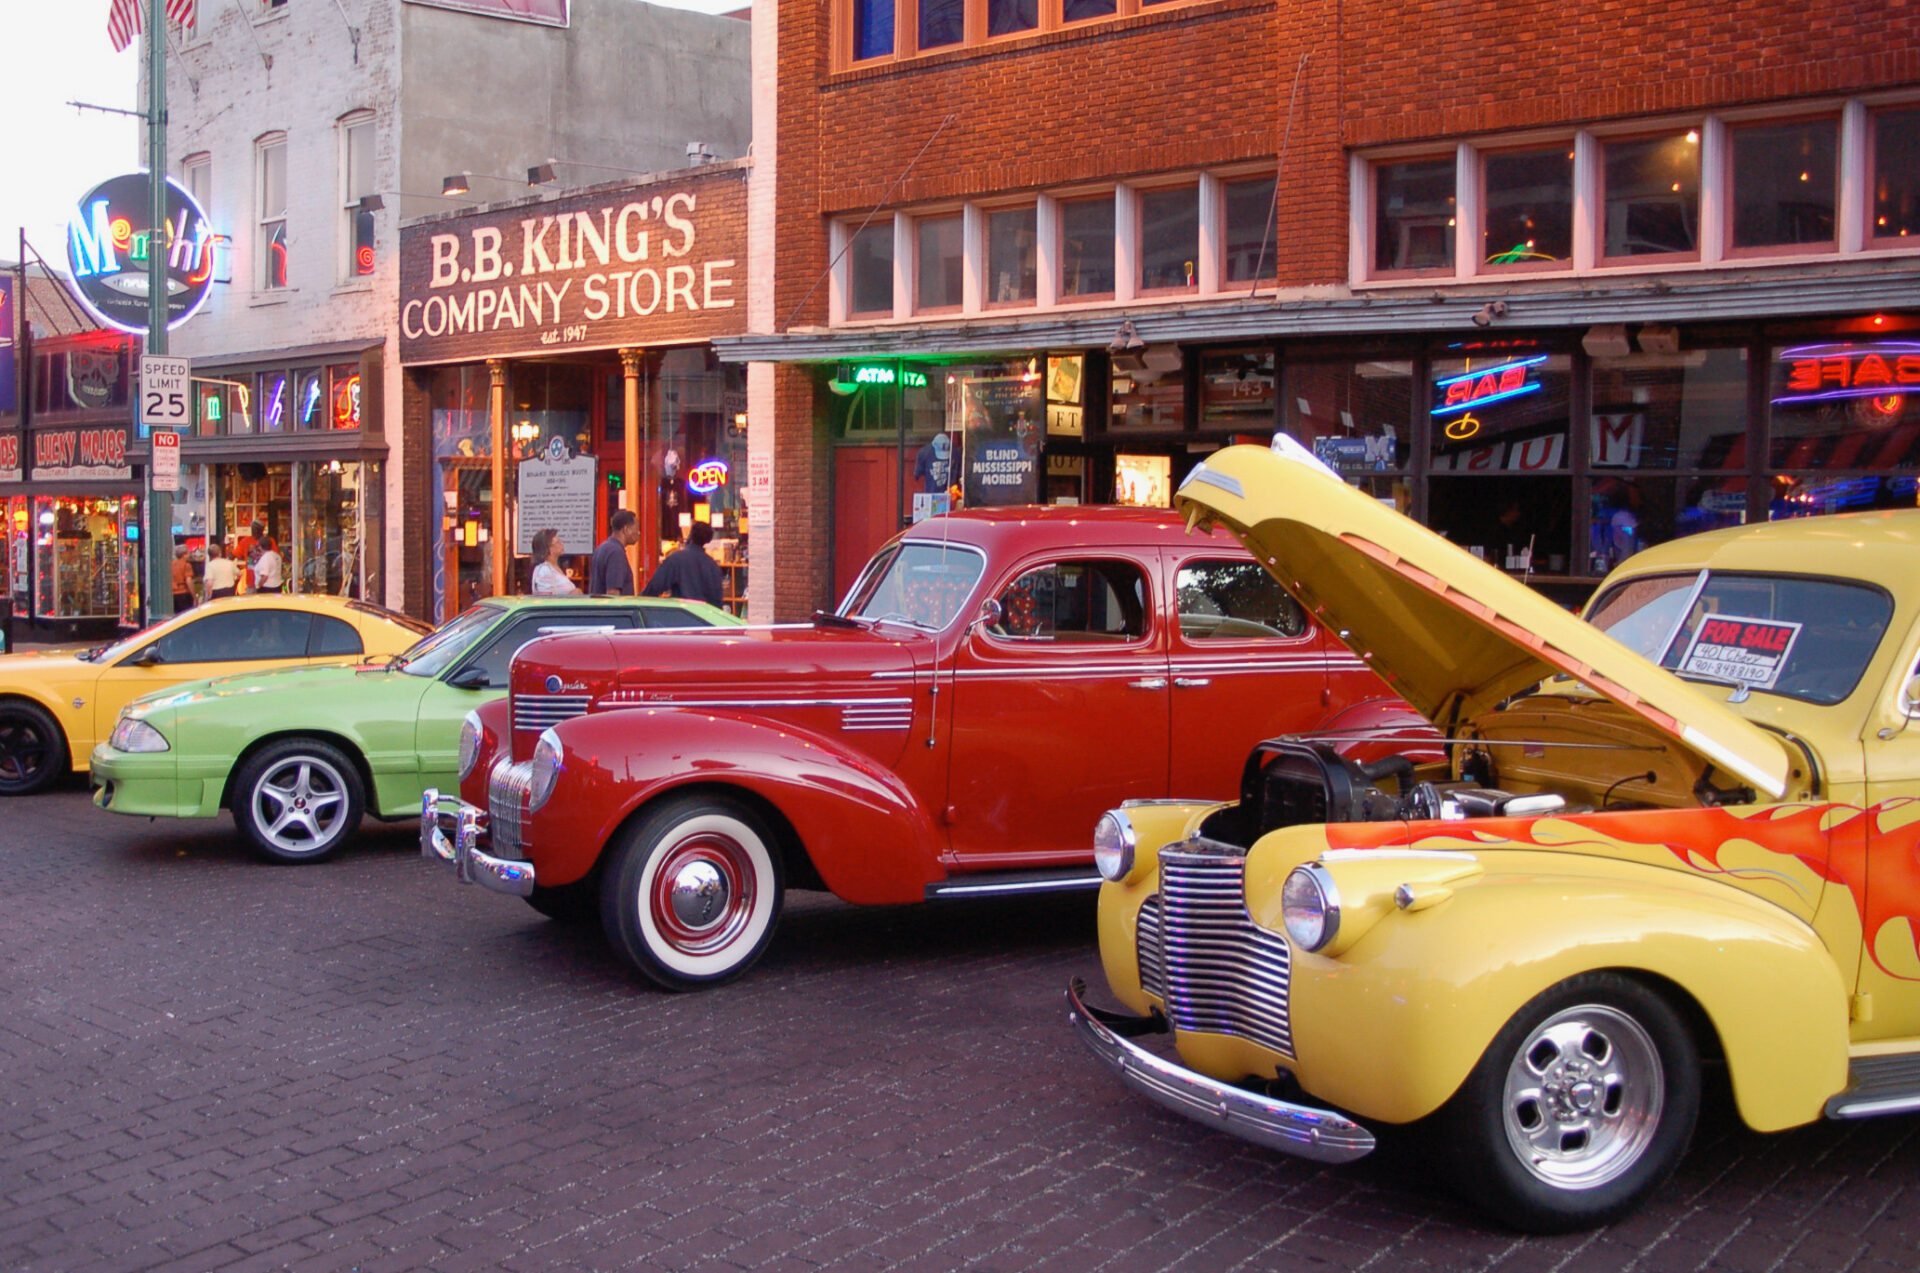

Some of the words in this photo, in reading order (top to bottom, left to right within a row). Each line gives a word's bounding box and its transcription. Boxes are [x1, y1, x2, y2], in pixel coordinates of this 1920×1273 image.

[67, 199, 225, 287] Memhis
[430, 227, 513, 288] B.B.
[520, 192, 698, 275] KING'S
[402, 278, 572, 339] COMPANY
[583, 259, 736, 320] STORE
[541, 328, 561, 345] est.
[562, 325, 587, 343] 1947
[145, 364, 185, 375] SPEED
[856, 367, 895, 383] ATM
[149, 379, 181, 389] LIMIT
[1232, 379, 1262, 397] 143
[146, 392, 185, 417] 25
[36, 431, 76, 466] LUCKY
[80, 429, 127, 466] MOJOS
[158, 435, 175, 446] NO
[985, 449, 1019, 461] BLIND
[688, 465, 728, 486] OPEN
[972, 460, 1032, 474] MISSISSIPPI
[982, 473, 1023, 486] MORRIS
[1700, 620, 1742, 645] FOR
[1740, 624, 1793, 652] SALE
